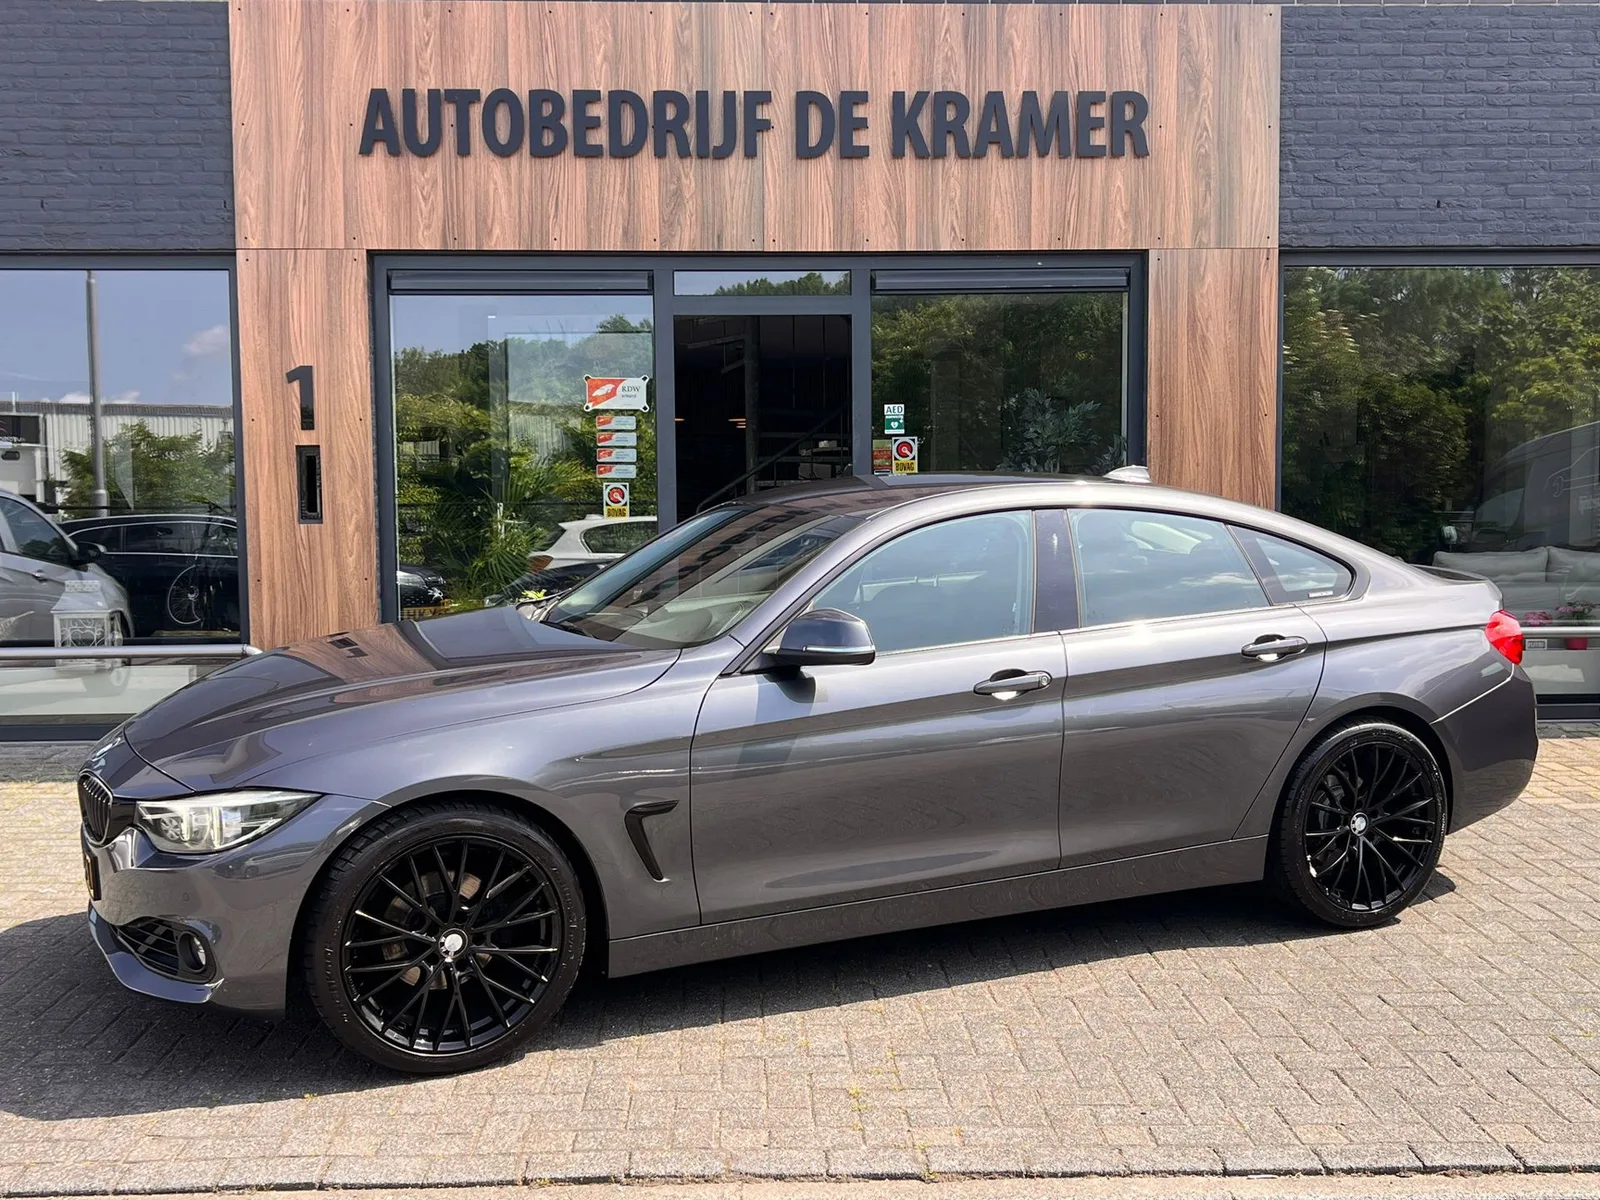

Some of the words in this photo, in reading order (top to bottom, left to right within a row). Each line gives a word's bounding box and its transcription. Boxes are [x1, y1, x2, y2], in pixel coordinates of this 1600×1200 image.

[359, 88, 772, 159] AUTOBEDRIJF
[796, 90, 870, 158] DE
[892, 90, 1150, 158] KRAMER
[621, 385, 641, 393] RDW
[285, 365, 315, 430] 1
[885, 405, 903, 414] AED
[895, 461, 915, 472] BOVAG
[606, 507, 627, 518] BOVAG
